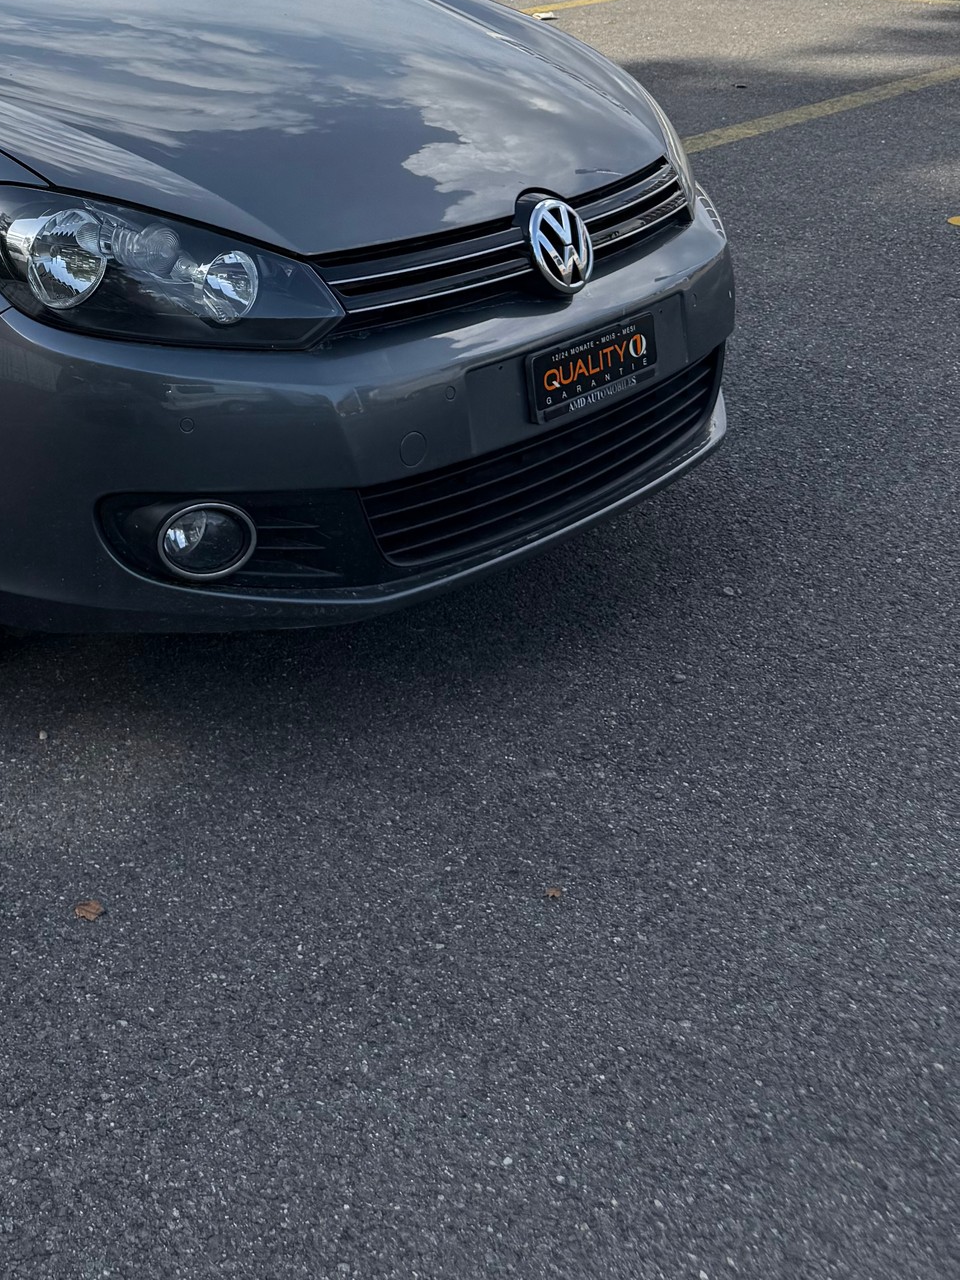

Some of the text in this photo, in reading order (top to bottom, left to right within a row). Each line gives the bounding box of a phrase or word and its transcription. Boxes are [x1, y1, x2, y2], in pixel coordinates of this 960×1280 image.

[529, 200, 593, 293] VW
[570, 341, 594, 355] MONATE
[601, 333, 615, 343] MOIS
[622, 325, 636, 335] MESI
[546, 357, 647, 404] GARANTIE
